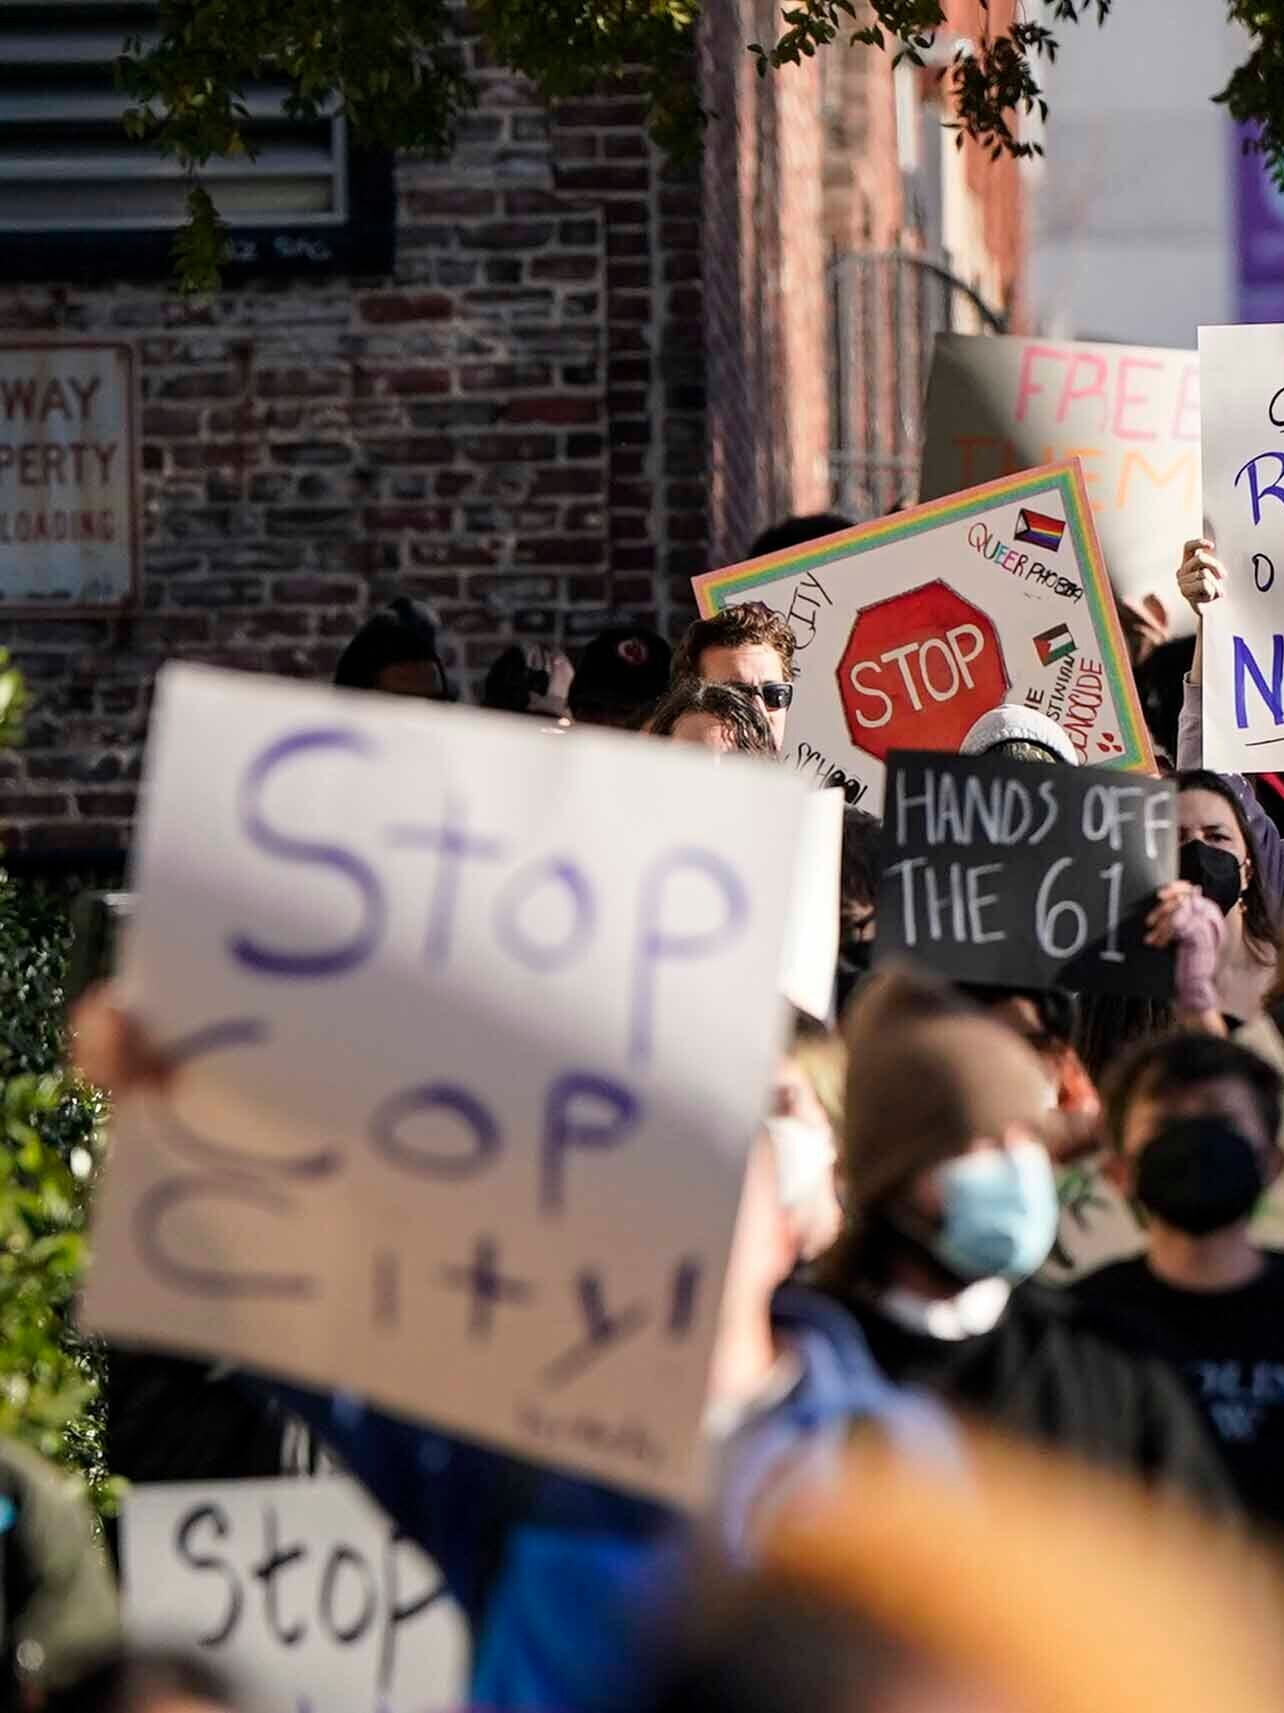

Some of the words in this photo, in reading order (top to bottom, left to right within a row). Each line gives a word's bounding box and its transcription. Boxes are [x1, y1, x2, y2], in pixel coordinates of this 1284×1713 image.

[0, 378, 102, 421] WAY
[953, 432, 1197, 513] TEM
[967, 521, 1029, 577] QUEER
[850, 623, 985, 729] STOP
[896, 768, 1059, 847] HANDS
[1081, 784, 1173, 860] OFF
[225, 726, 752, 1076] Stop
[883, 856, 1007, 947] THE
[1035, 856, 1127, 963] 61
[175, 1501, 446, 1700] Stop
